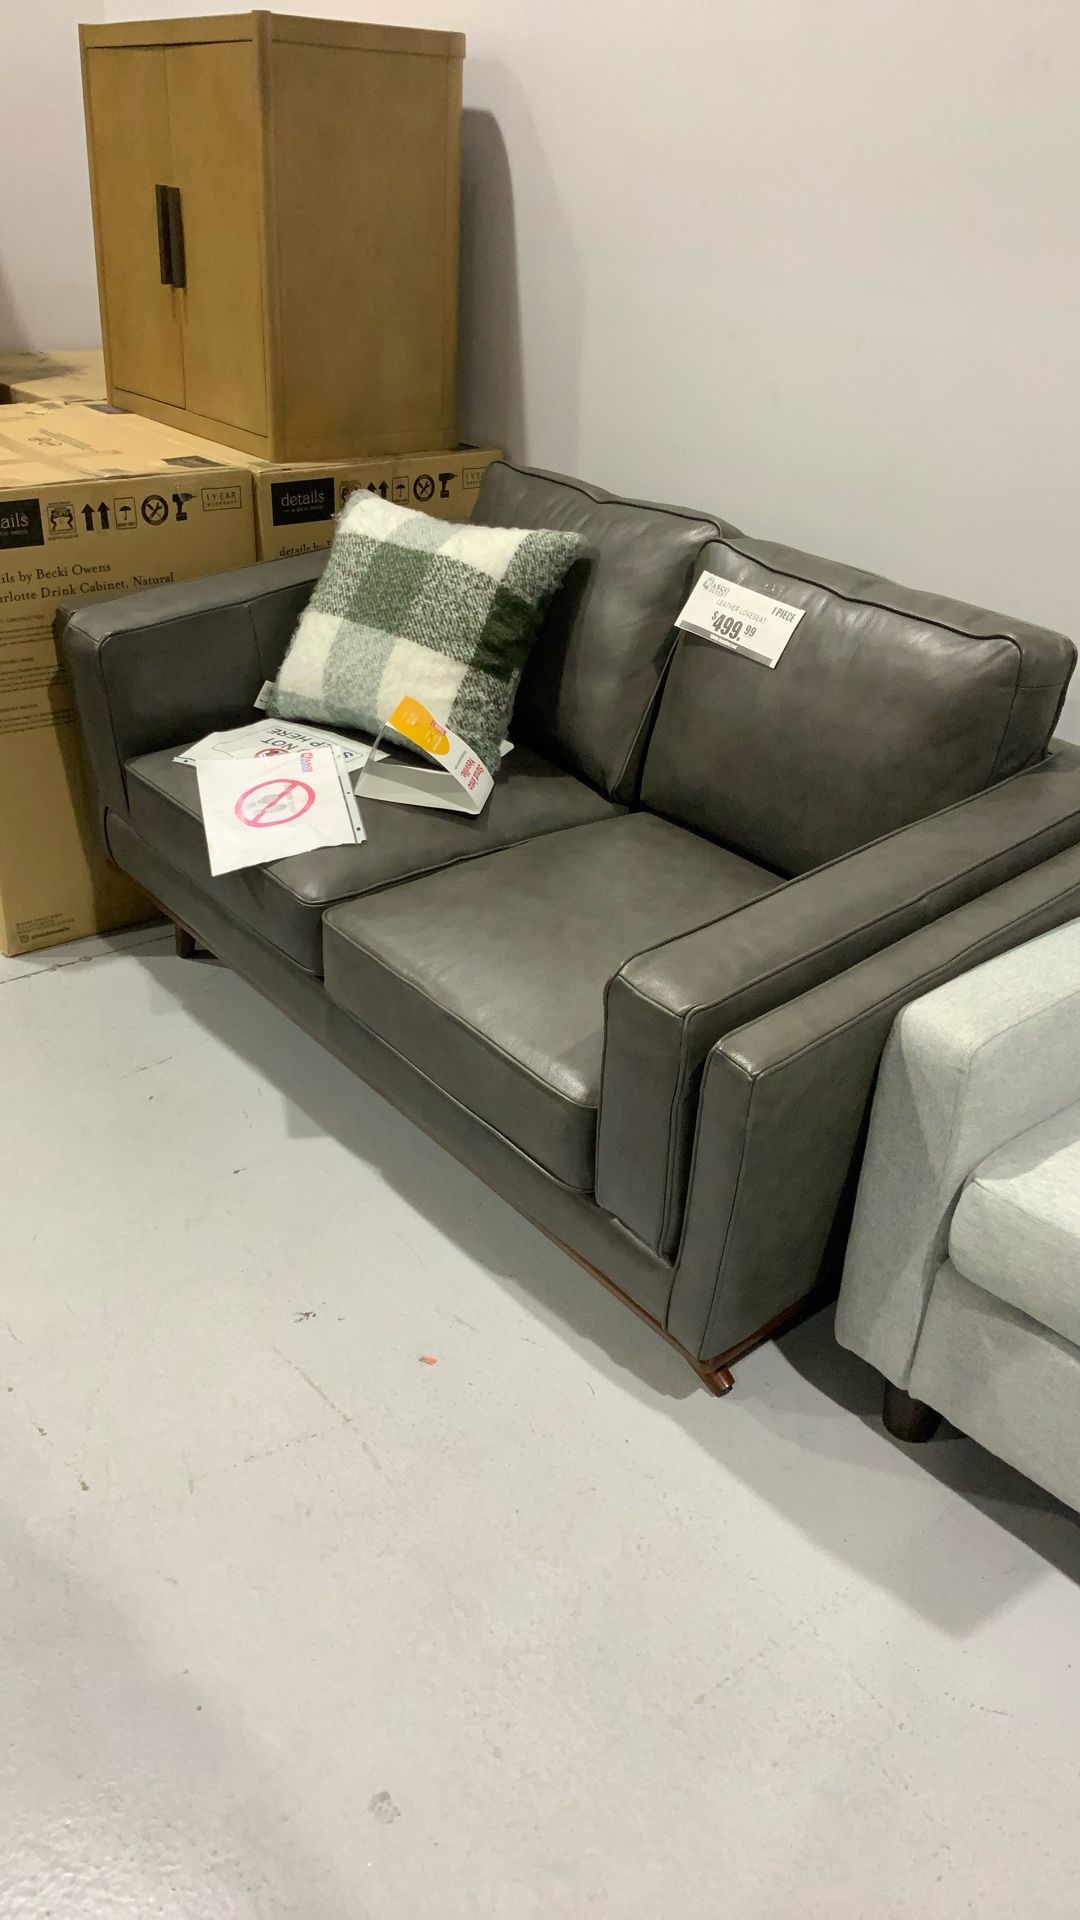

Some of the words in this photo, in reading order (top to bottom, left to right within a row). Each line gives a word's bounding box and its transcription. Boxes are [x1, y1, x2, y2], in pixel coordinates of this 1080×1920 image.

[280, 490, 325, 507] details
[0, 512, 29, 529] ails
[1, 572, 16, 584] ils
[18, 571, 32, 584] by
[35, 566, 68, 580] Becki
[71, 564, 111, 576] Owens
[41, 584, 77, 598] Drink
[80, 580, 129, 594] Cabinet,
[132, 571, 174, 587] Natural
[716, 599, 741, 613] LEATHER
[739, 607, 767, 623] LOVESEAT
[775, 607, 796, 623] PIECE
[260, 737, 298, 751] NOT
[266, 728, 312, 743] HERE
